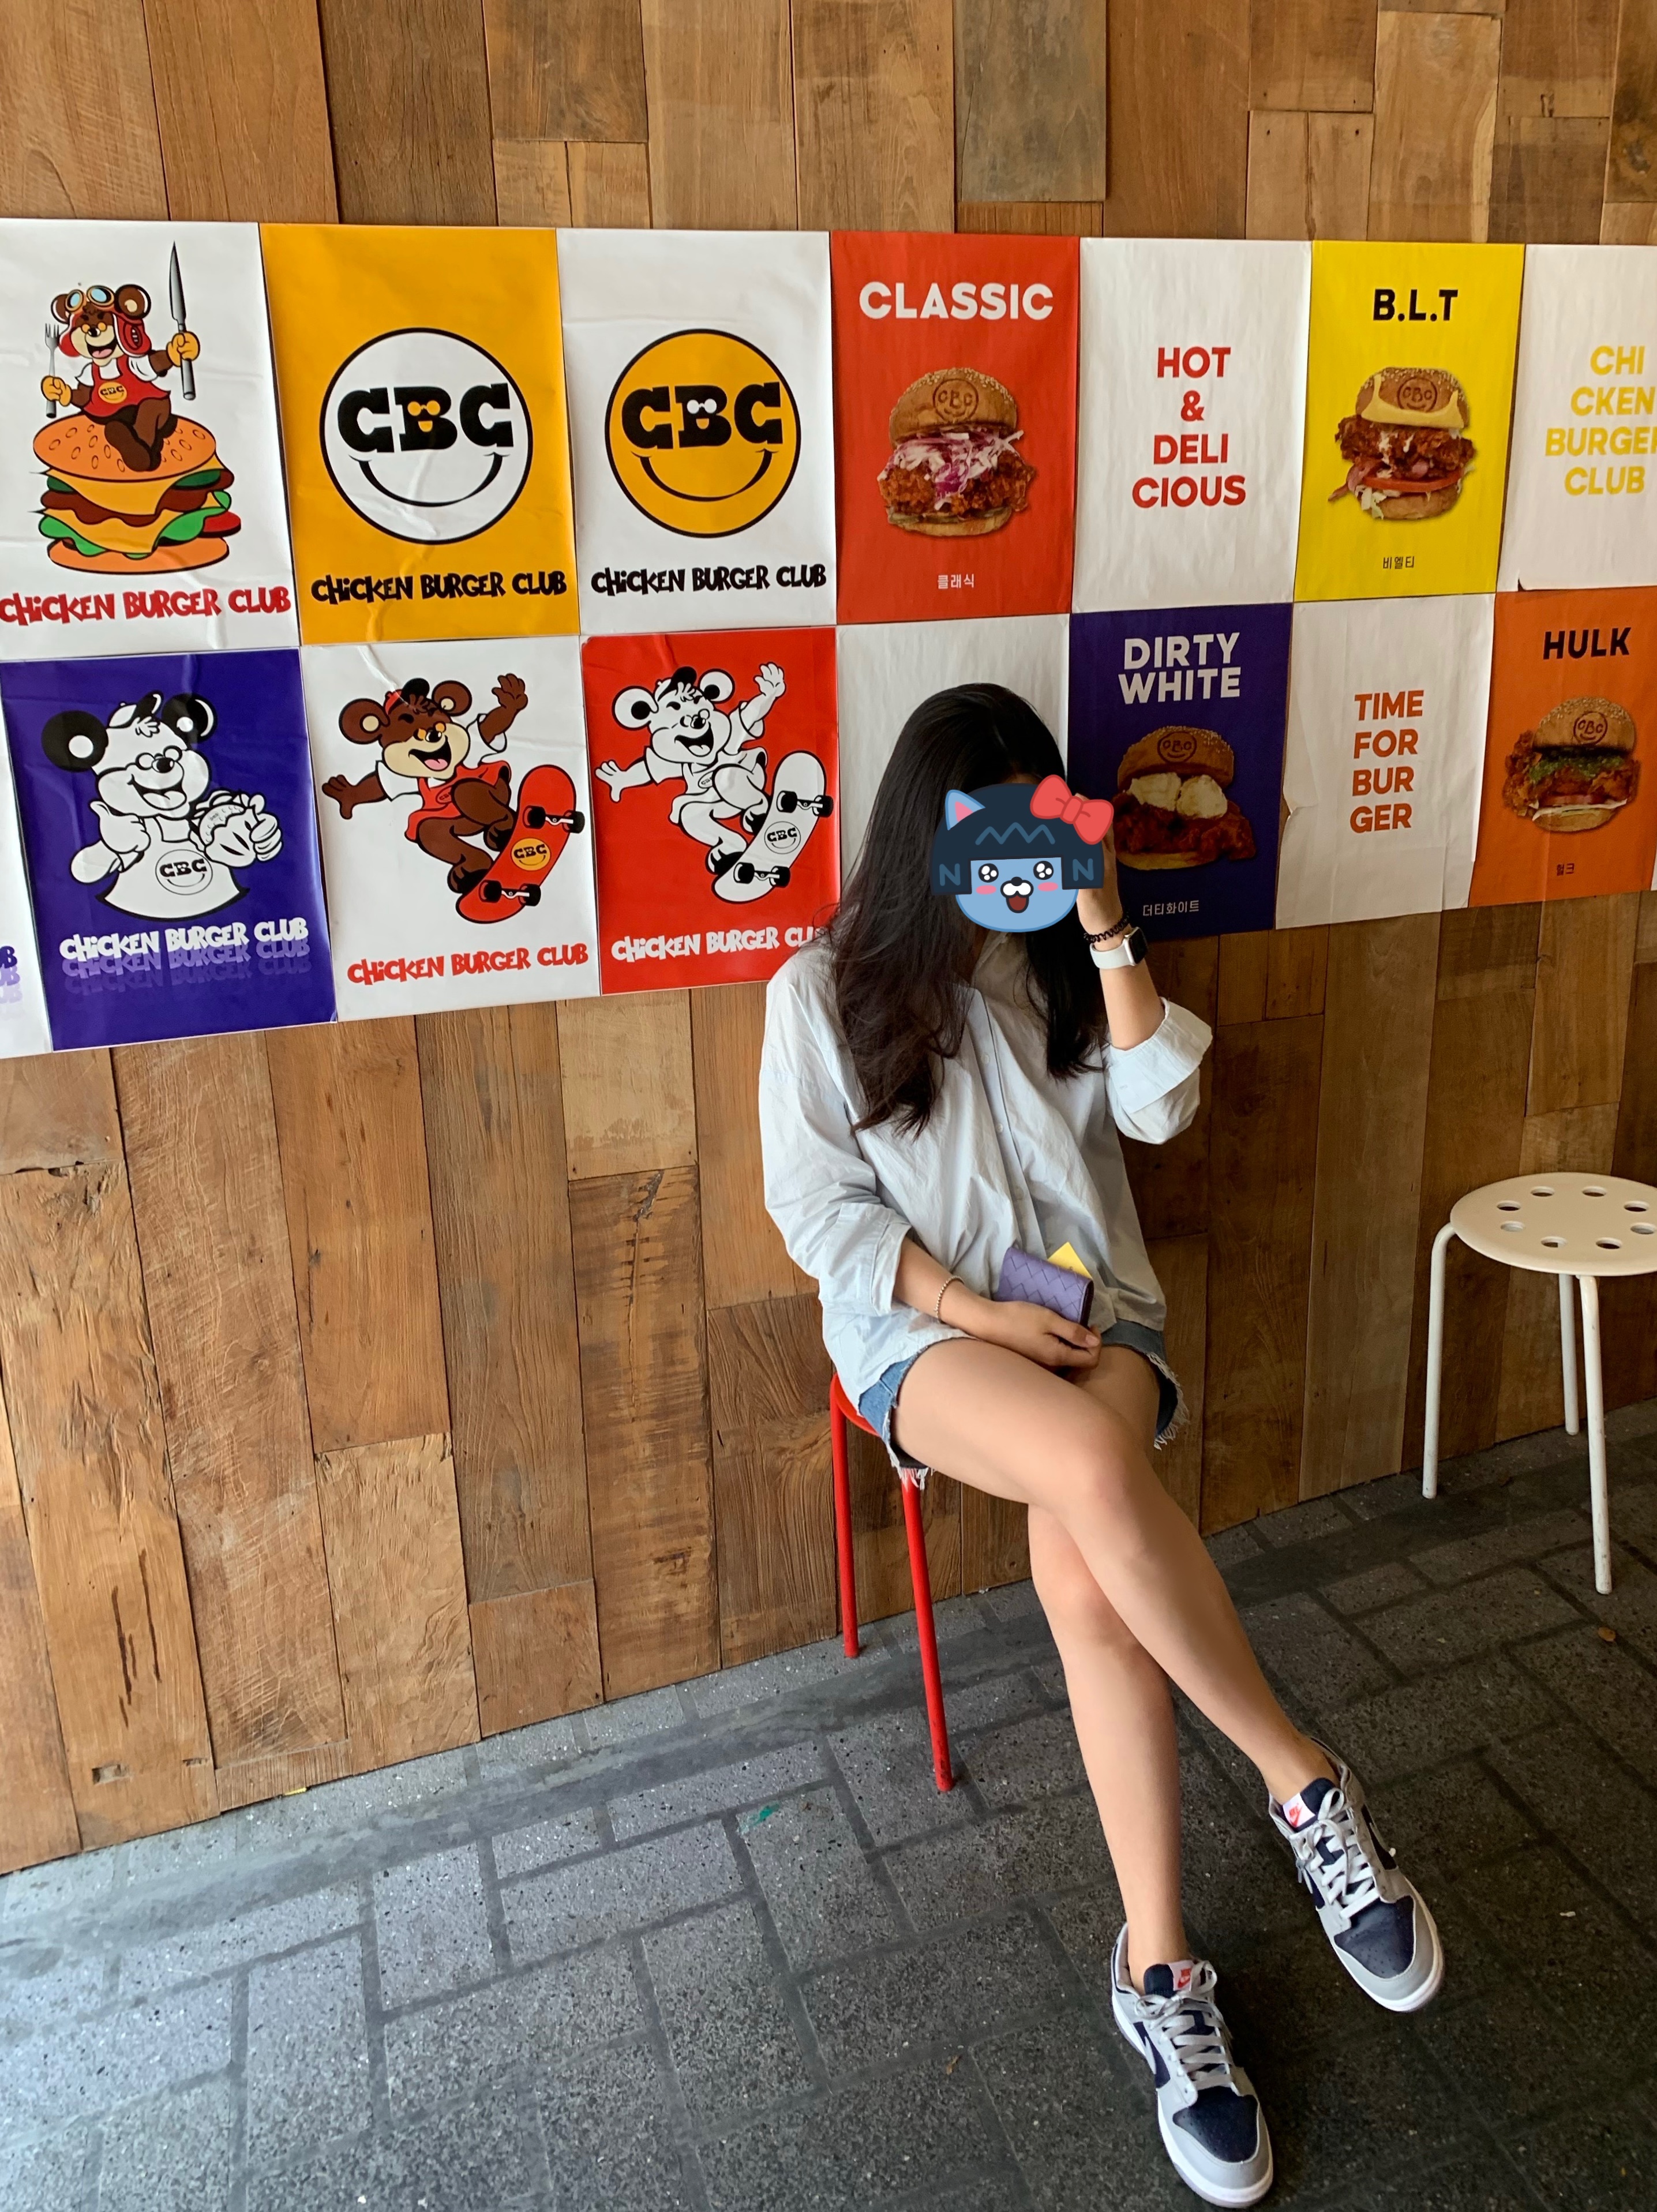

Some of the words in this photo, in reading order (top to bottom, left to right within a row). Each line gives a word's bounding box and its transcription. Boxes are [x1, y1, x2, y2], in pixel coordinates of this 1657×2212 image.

[859, 282, 1053, 320] CLASSIC
[1373, 289, 1458, 321] B.L.T
[1157, 347, 1231, 378] HOT
[1590, 345, 1645, 376] CHI
[622, 382, 783, 449] CBC
[1180, 391, 1204, 421] &
[1570, 386, 1655, 416] CKEN
[337, 383, 515, 453] CBC
[1153, 434, 1228, 465] DELI
[1132, 475, 1246, 508] CIOUS
[1564, 466, 1645, 496] CLUB
[692, 565, 770, 591] BURGER
[776, 564, 827, 588] CLUB
[1383, 556, 1415, 569] 비엘티
[420, 572, 506, 599] BURGER
[512, 571, 567, 595] CLUB
[938, 573, 974, 589] 클래식
[123, 588, 222, 619] BURGER
[228, 586, 292, 613] CLUB
[1124, 632, 1240, 670] DIRTY
[1543, 627, 1631, 660] HULK
[1118, 667, 1242, 704] WHITE
[1354, 690, 1424, 721] TIME
[1354, 729, 1418, 759] FOR
[1352, 766, 1414, 797] BUR
[1350, 803, 1412, 834] GER
[767, 827, 797, 842] CBC
[513, 843, 547, 858] CBC
[159, 858, 207, 877] CBC
[1143, 900, 1199, 916] 더티화이트
[165, 923, 249, 951] BURGER
[254, 917, 309, 942] CLUB
[706, 927, 779, 954] BURGER
[451, 948, 531, 976] BURGER
[537, 943, 588, 966] CLUB
